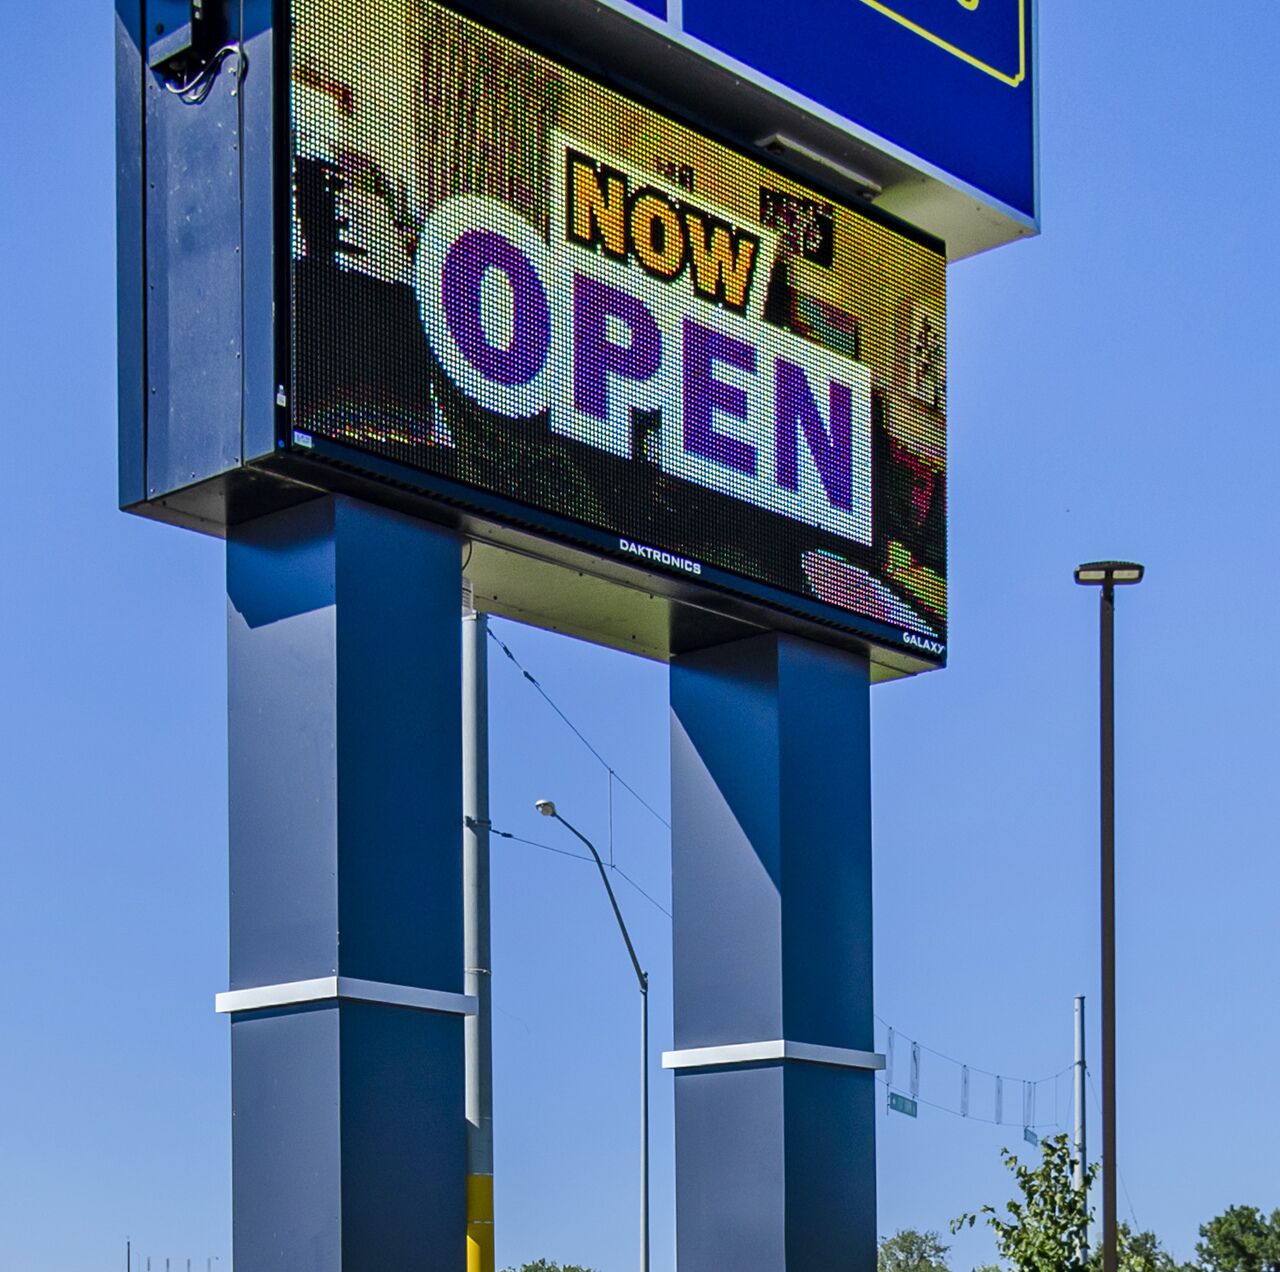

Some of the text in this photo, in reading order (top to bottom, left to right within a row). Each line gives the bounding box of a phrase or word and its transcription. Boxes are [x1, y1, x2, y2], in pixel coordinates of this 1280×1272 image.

[568, 158, 758, 310] NOW
[441, 228, 854, 513] OPEN
[619, 538, 702, 575] DAKTRONICS
[902, 631, 945, 655] GALAXY
